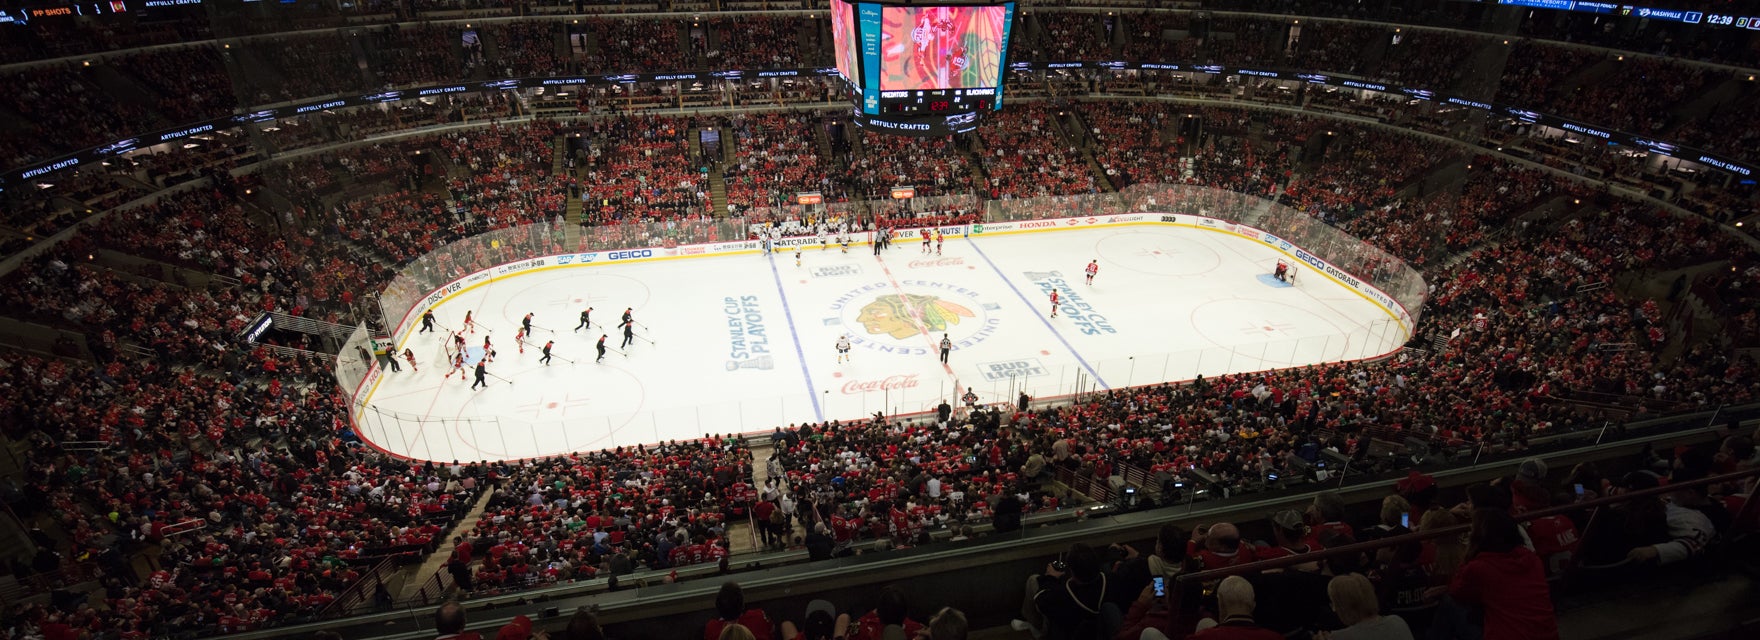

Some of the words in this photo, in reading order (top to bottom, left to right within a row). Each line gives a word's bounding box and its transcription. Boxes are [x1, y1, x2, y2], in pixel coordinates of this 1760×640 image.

[45, 8, 72, 16] SHOTS
[1651, 10, 1682, 18] NASHVILLE
[1707, 14, 1733, 24] 12:39
[297, 104, 322, 113] ARTFULLY
[322, 100, 345, 108] CRAFTED
[1448, 98, 1471, 106] ARTFULLY
[1471, 101, 1492, 110] CRAFTED
[870, 120, 898, 128] ARTFULLY
[1562, 123, 1587, 133] ARTFULLY
[1587, 128, 1611, 139] CRAFTED
[160, 130, 188, 141] ARTFULLY
[189, 124, 213, 134] CRAFTED
[22, 165, 52, 179] ARTFULLY
[52, 158, 79, 170] CRAFTED
[1699, 156, 1726, 168] ARTFULLY
[1726, 163, 1750, 176] CRAFTED
[1019, 220, 1057, 230] HONDA
[608, 250, 652, 260] GEICO
[908, 256, 964, 268] Coca-Cola
[1296, 250, 1325, 270] GEICO
[1326, 266, 1360, 288] GATORADE
[428, 282, 462, 304] DISCOVER
[830, 282, 886, 310] UNITED
[902, 280, 980, 298] CENTER
[1365, 288, 1388, 304] UNITED
[724, 296, 741, 315] CUP
[1048, 278, 1096, 312] STANLEY
[1088, 314, 1117, 334] CUP
[740, 296, 770, 354] PLAYOFFS
[728, 316, 749, 359] STANLEY
[986, 366, 1042, 380] LIGHT
[988, 361, 1030, 372] BUD
[841, 372, 920, 394] Coca-Cola
